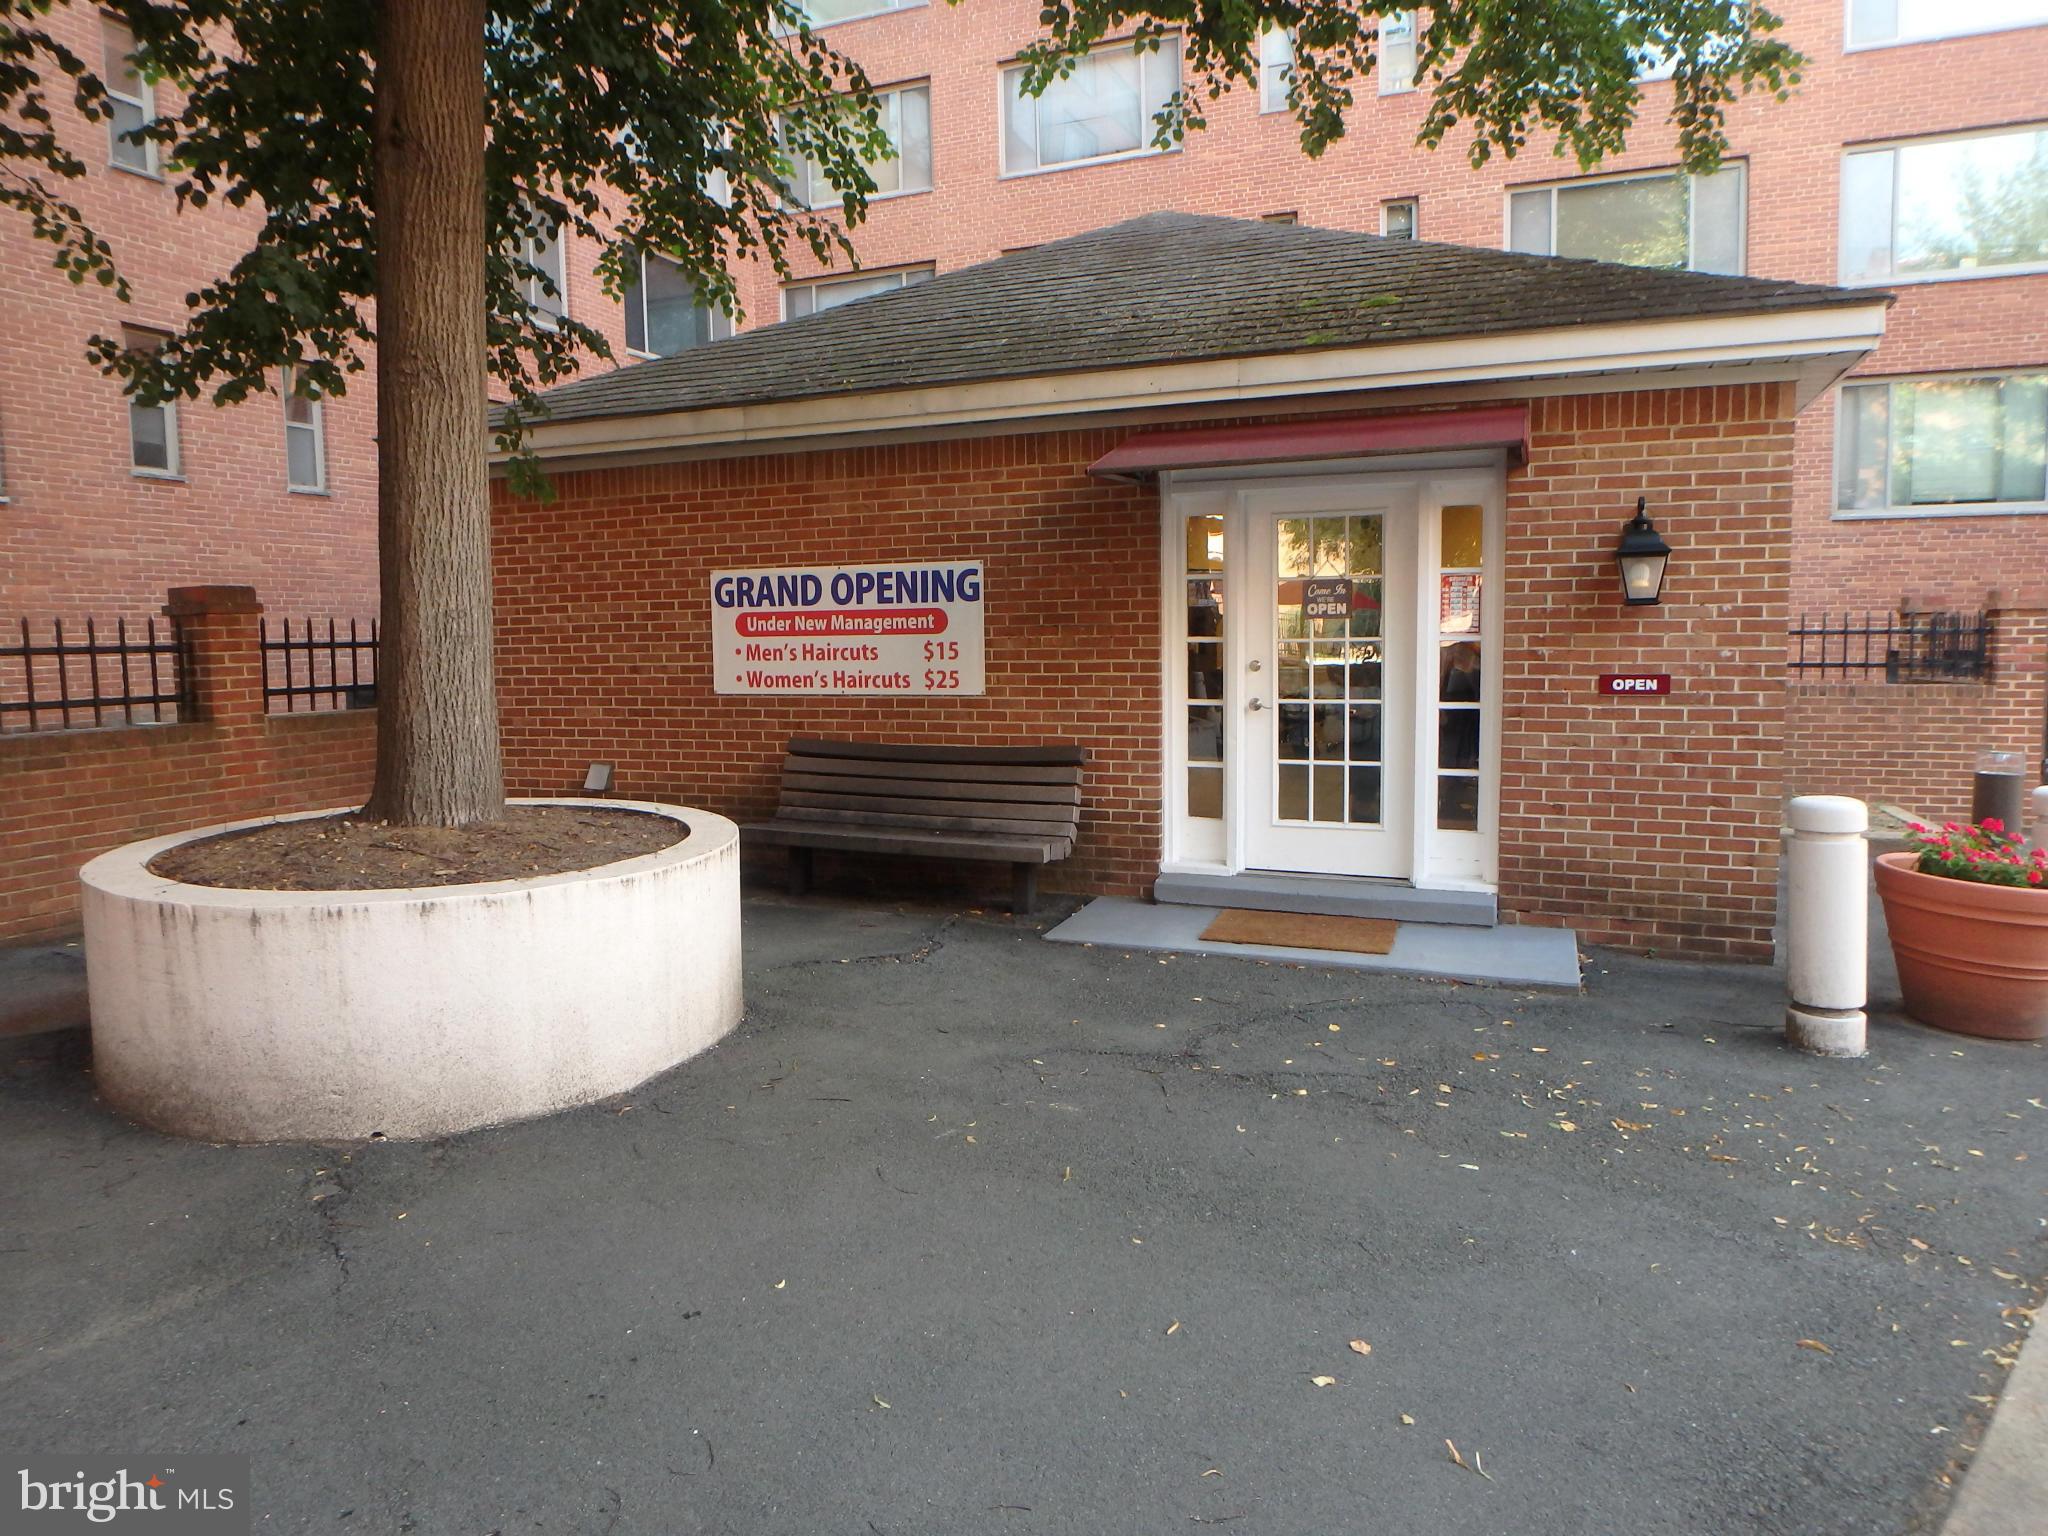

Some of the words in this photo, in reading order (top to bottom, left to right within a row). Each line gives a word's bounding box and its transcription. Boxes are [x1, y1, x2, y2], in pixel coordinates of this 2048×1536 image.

[714, 573, 823, 608] GRAND
[830, 568, 980, 606] OPENING
[1307, 584, 1331, 597] Come
[1333, 583, 1346, 595] In
[1306, 602, 1347, 615] OPEN
[746, 615, 791, 632] Under
[794, 615, 827, 631] New
[830, 613, 935, 634] Management
[746, 642, 797, 662] Men's
[802, 642, 879, 661] Haircuts
[923, 641, 959, 661] $15
[747, 670, 828, 689] Women's
[833, 669, 911, 689] Haircuts
[924, 669, 960, 689] $25
[1612, 678, 1658, 691] OPEN
